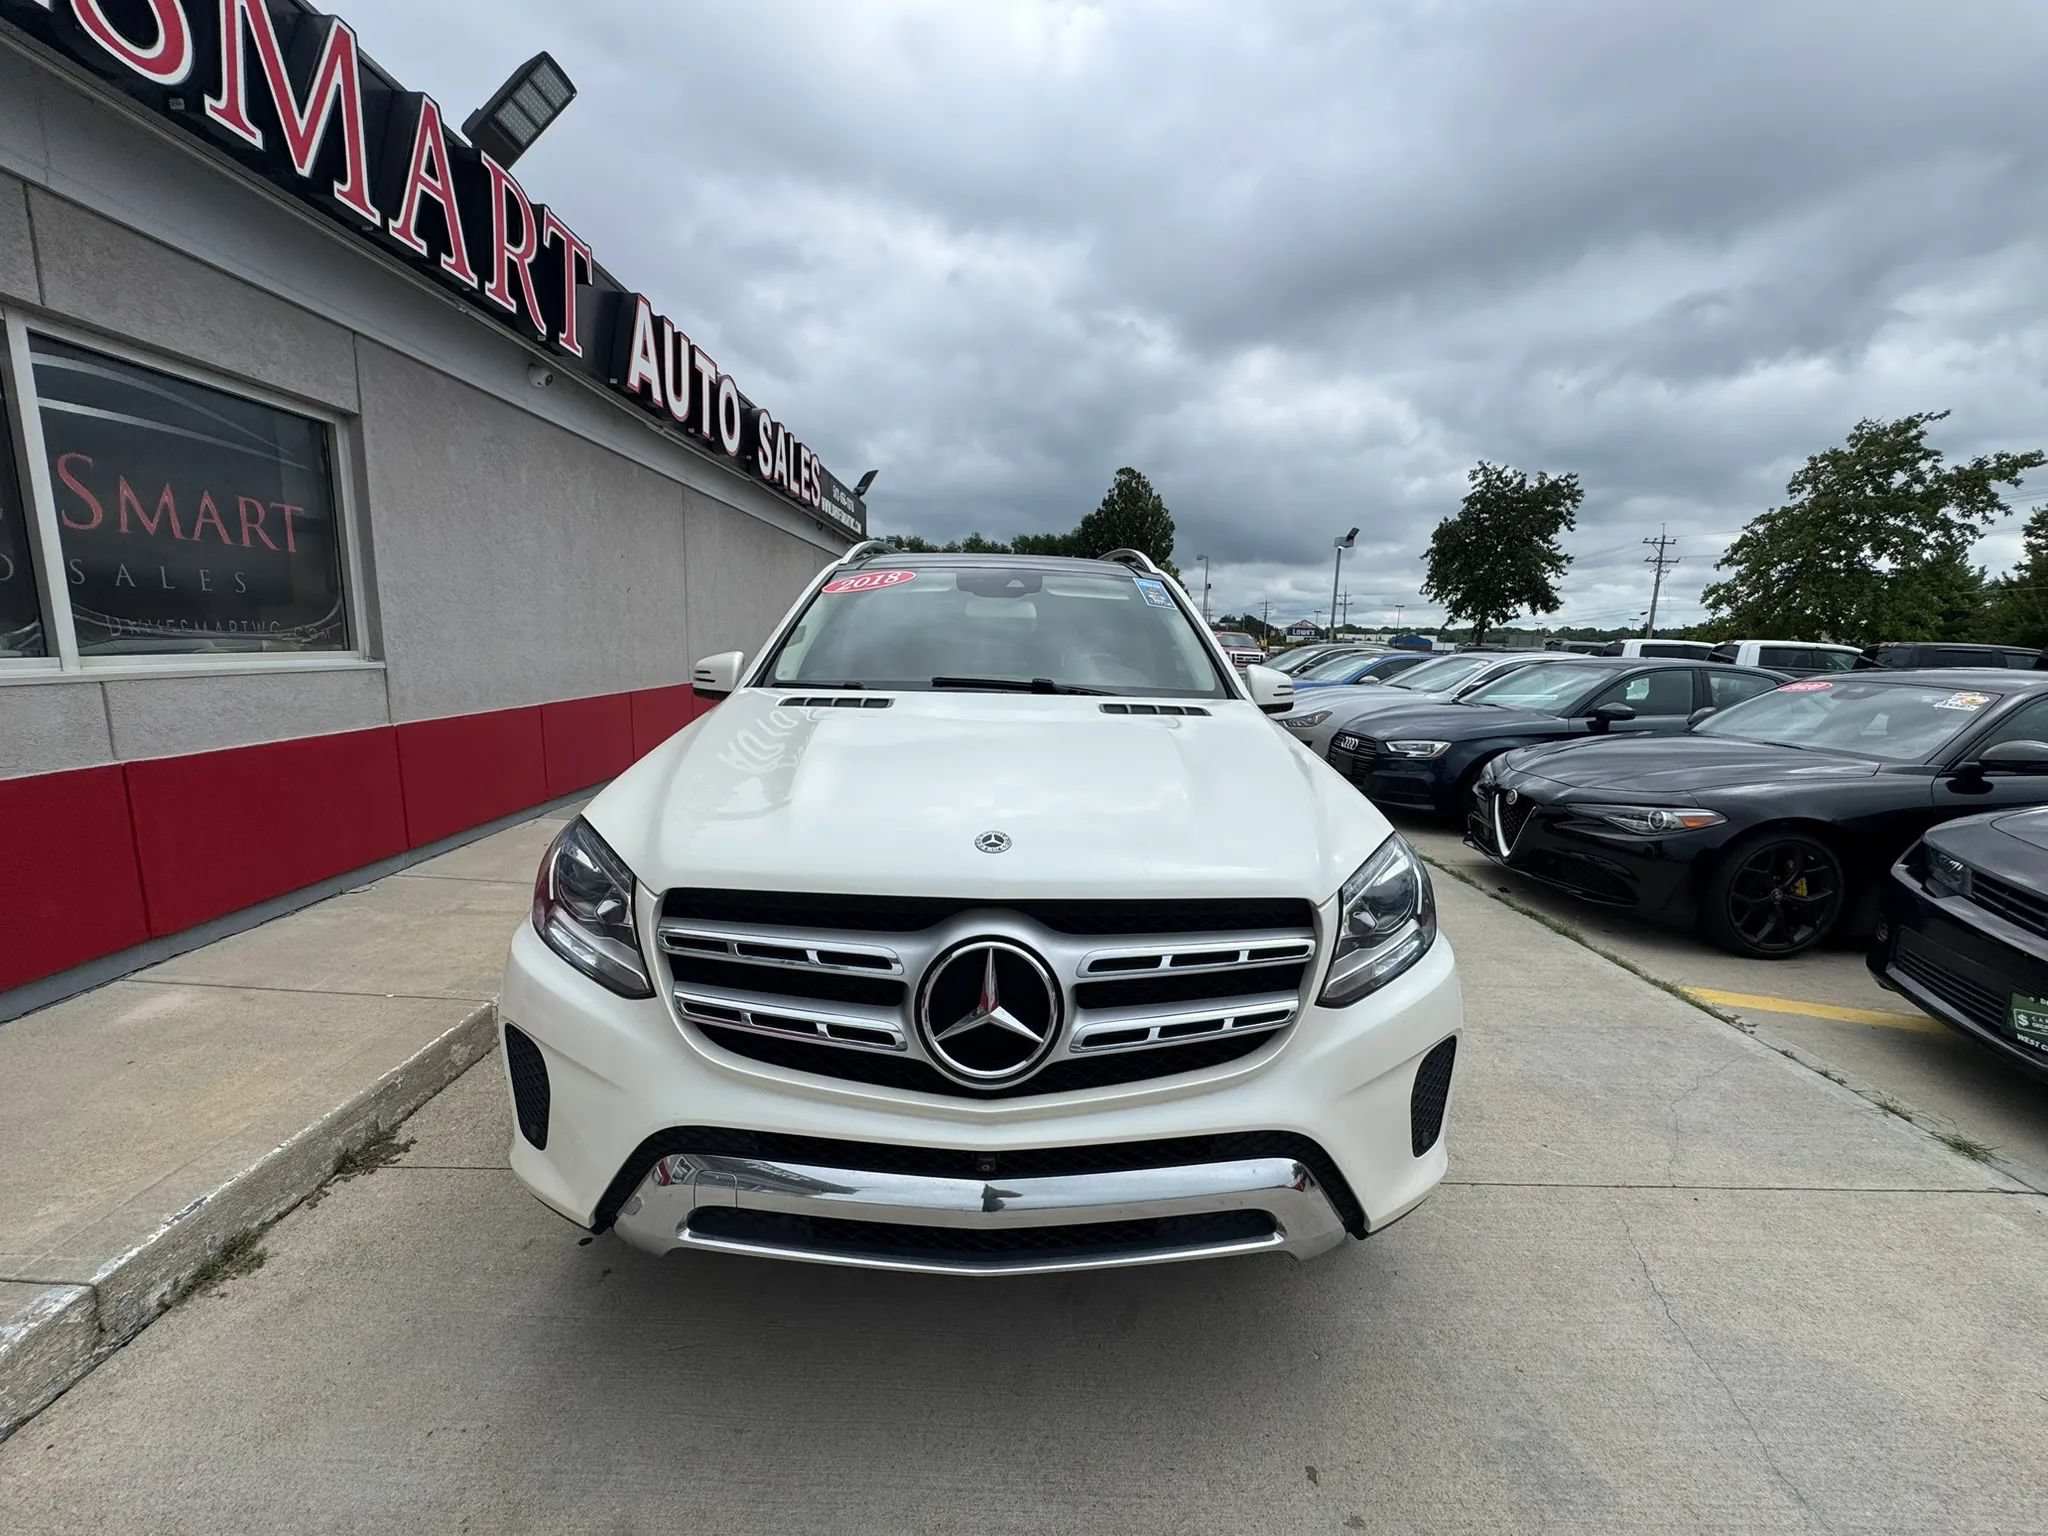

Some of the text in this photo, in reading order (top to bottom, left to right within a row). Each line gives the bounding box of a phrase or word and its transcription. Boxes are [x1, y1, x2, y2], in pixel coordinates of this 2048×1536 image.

[627, 293, 742, 456] AUTO
[757, 409, 822, 510] SALES
[56, 452, 304, 553] SMART
[69, 558, 248, 593] SALES
[833, 571, 902, 592] 2018
